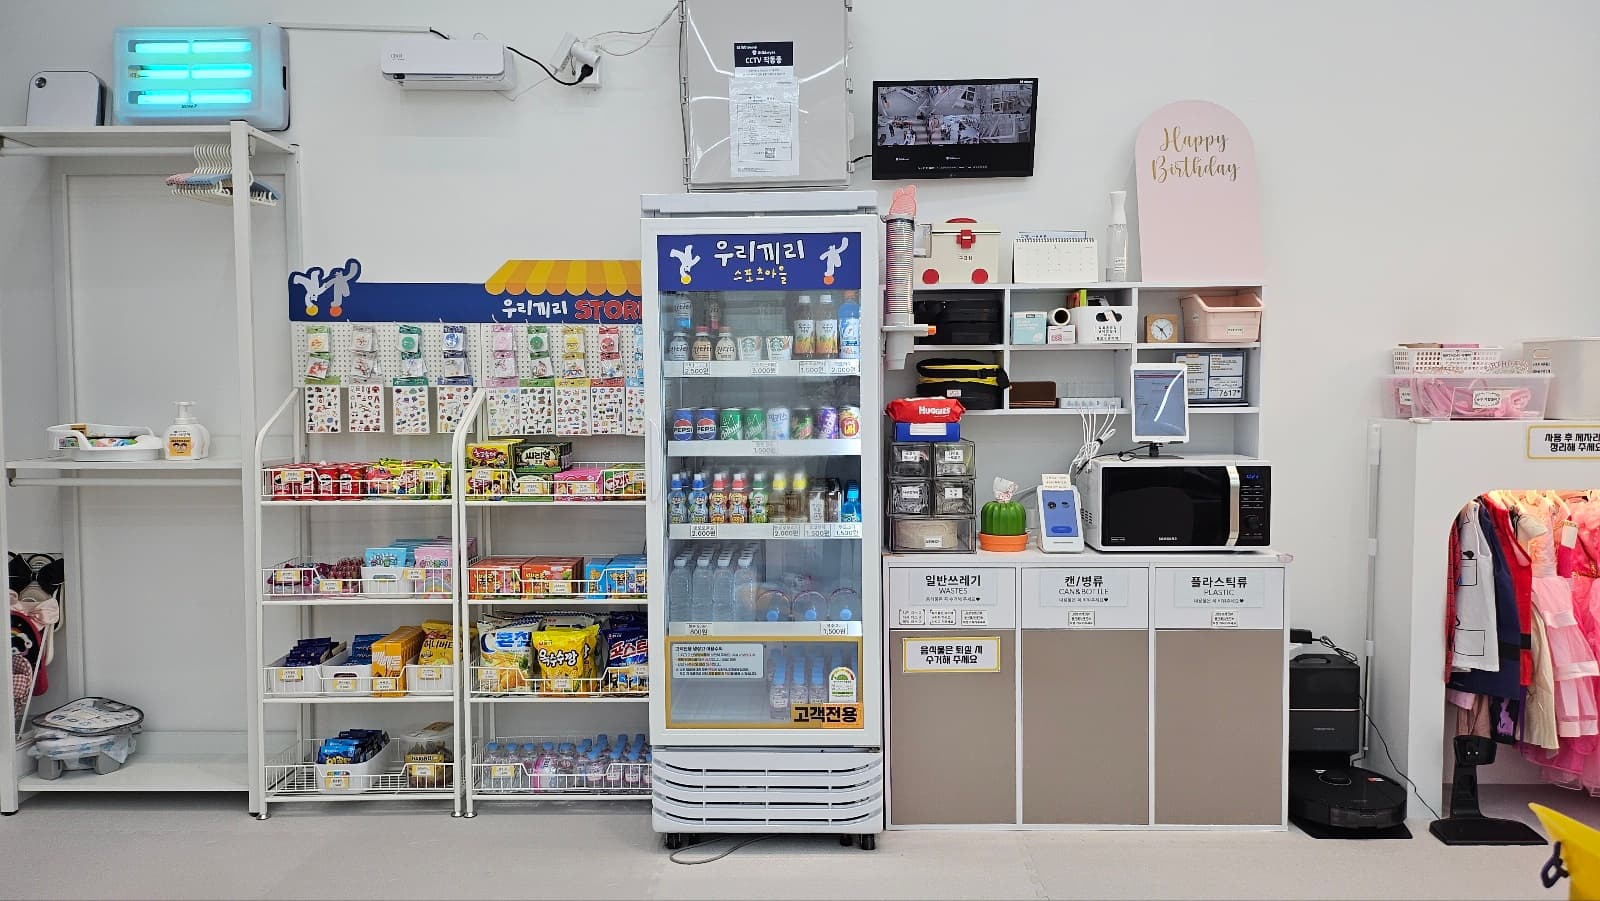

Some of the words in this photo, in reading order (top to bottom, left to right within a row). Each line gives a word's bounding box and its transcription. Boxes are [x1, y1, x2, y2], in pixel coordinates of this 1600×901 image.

[763, 56, 782, 64] 작동중
[1159, 126, 1229, 152] Happy
[1151, 155, 1241, 183] Birthday
[713, 239, 805, 267] 우리끼리
[502, 299, 568, 319] 우리끼리
[575, 299, 643, 321] STOR
[1545, 433, 1562, 442] 사용
[1564, 433, 1573, 442] 후
[1550, 443, 1576, 452] 정리해
[925, 575, 981, 587] 일반쓰레기
[1064, 575, 1104, 587] 캔/병류
[1191, 576, 1248, 588] 플라스틱류
[920, 645, 953, 654] 음식물은
[955, 645, 972, 654] 퇴실
[538, 648, 579, 667] 옥수수깡
[926, 655, 951, 665] 수거해
[953, 655, 978, 665] 주세요
[794, 706, 858, 722] 고객전용
